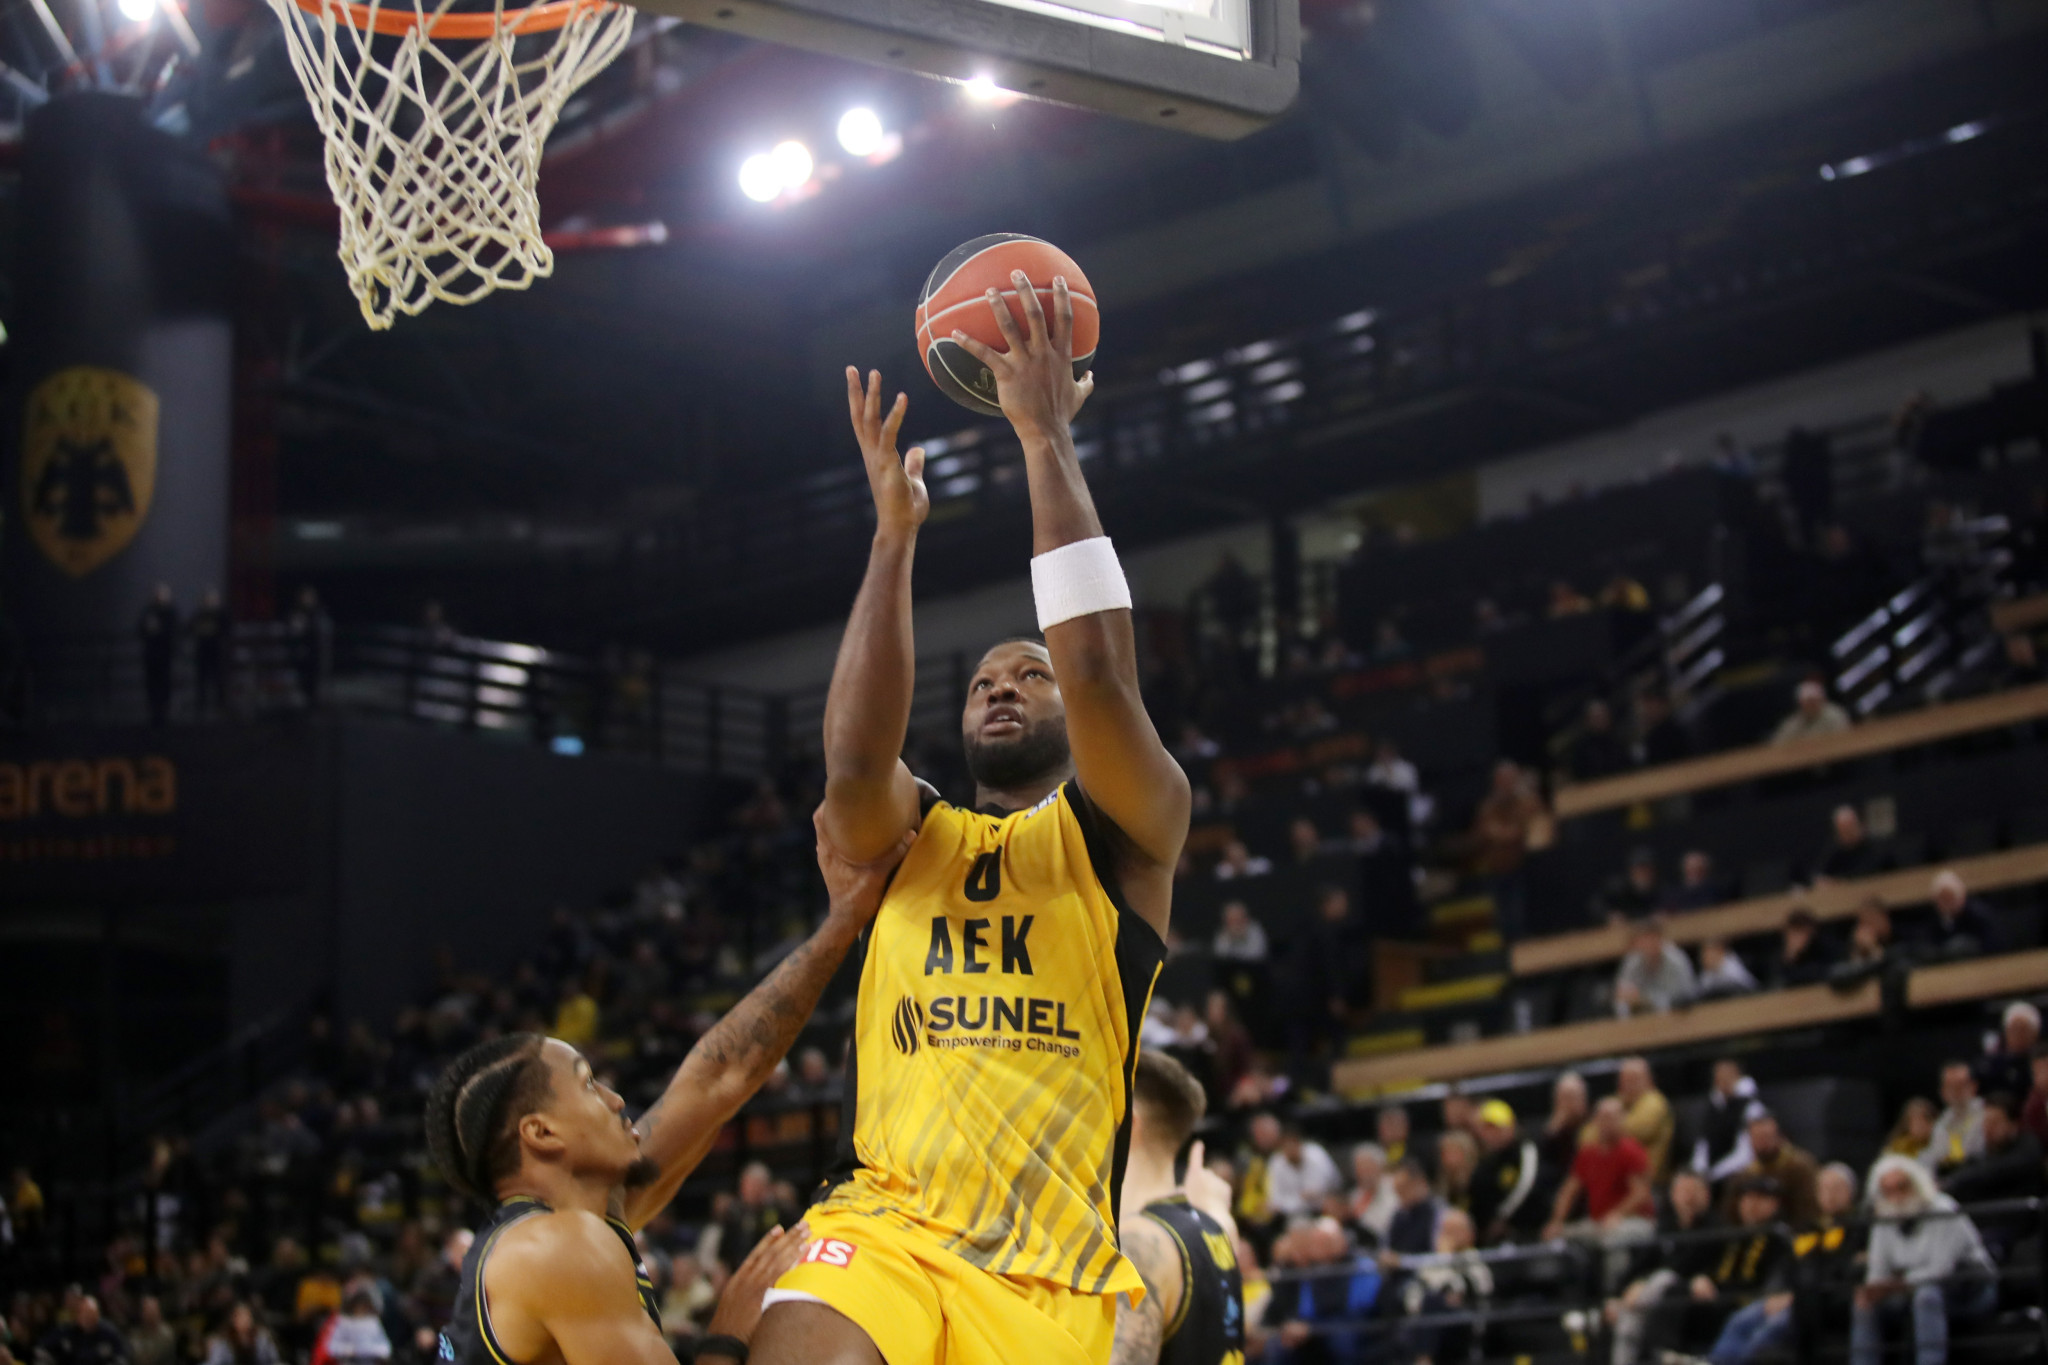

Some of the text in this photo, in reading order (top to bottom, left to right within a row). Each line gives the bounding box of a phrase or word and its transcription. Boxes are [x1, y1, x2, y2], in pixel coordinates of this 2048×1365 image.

[0, 757, 177, 821] arena
[924, 914, 1035, 976] AEK
[927, 996, 1080, 1041] SUNEL
[927, 1033, 1080, 1057] Empowering Change
